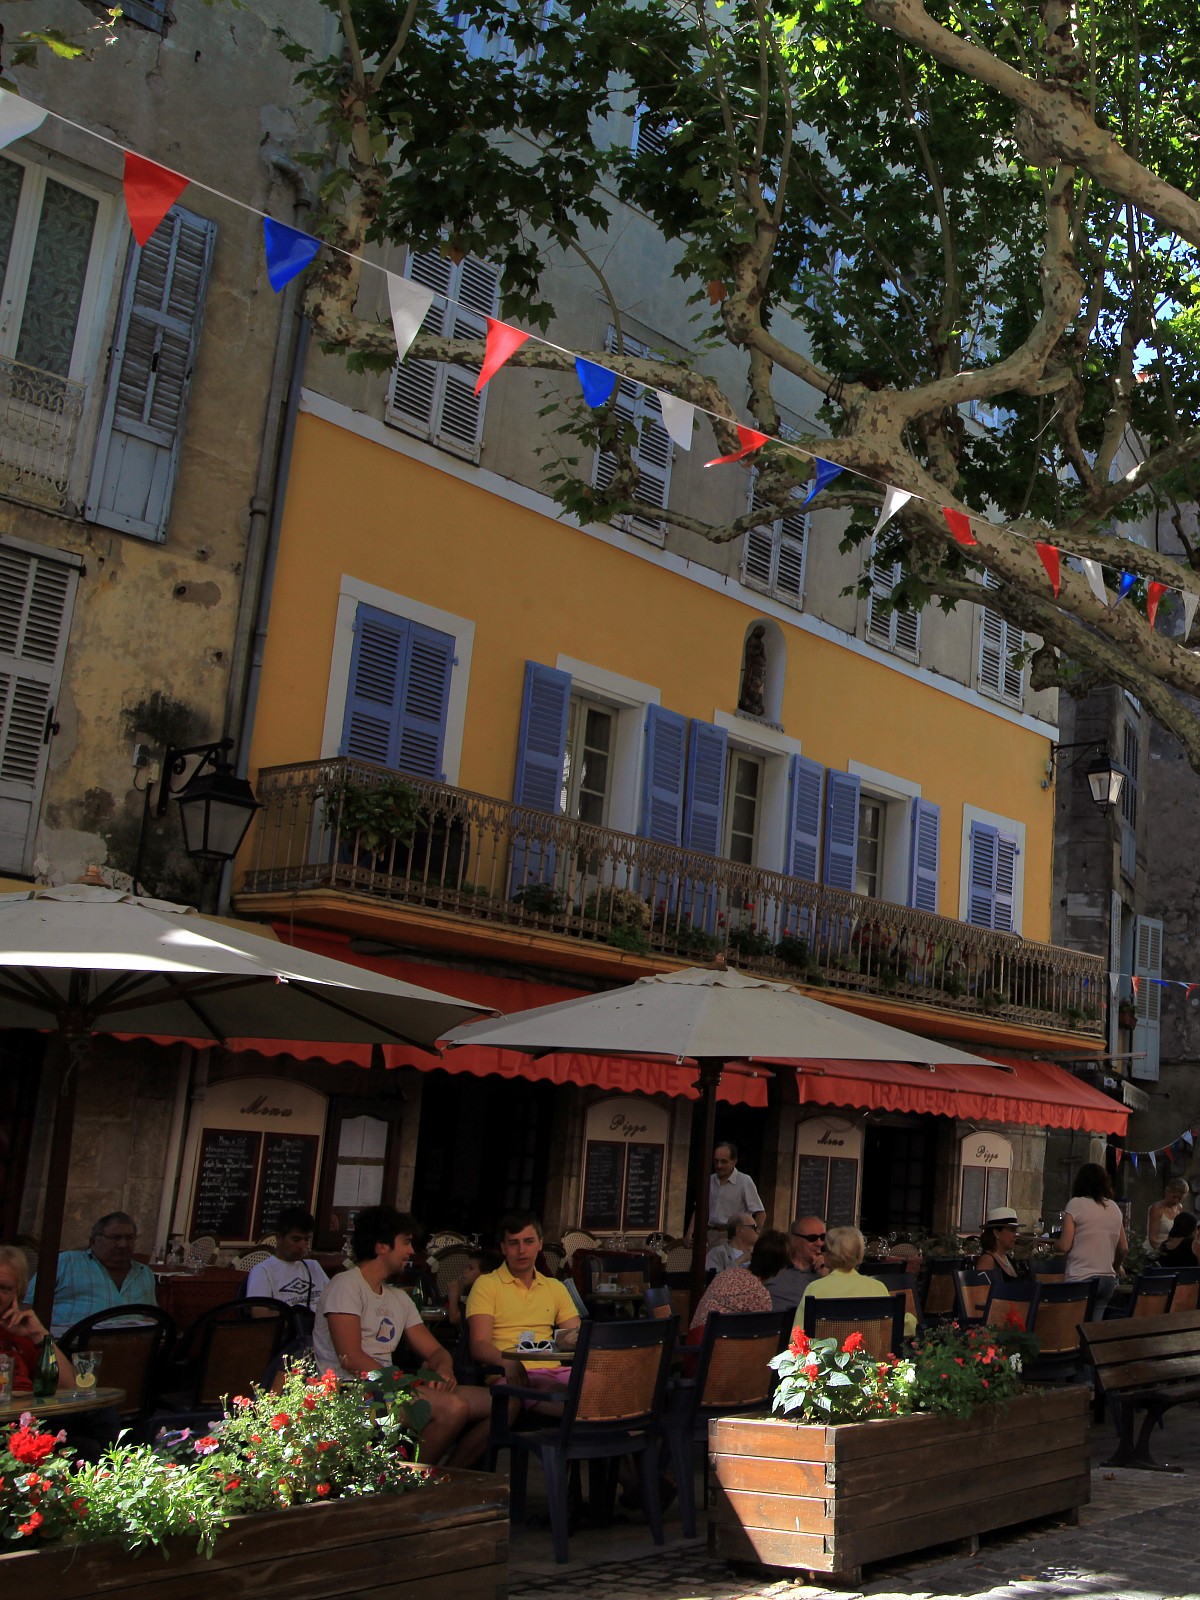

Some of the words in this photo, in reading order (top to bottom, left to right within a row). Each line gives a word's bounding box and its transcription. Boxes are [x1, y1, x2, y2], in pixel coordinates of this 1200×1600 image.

[496, 1047, 538, 1074] LA
[551, 1052, 680, 1091] TAVERNE
[240, 1095, 293, 1117] Menu
[869, 1082, 958, 1112] TRAITEUR
[609, 1114, 647, 1137] Pizza
[976, 1145, 999, 1163] Pizza
